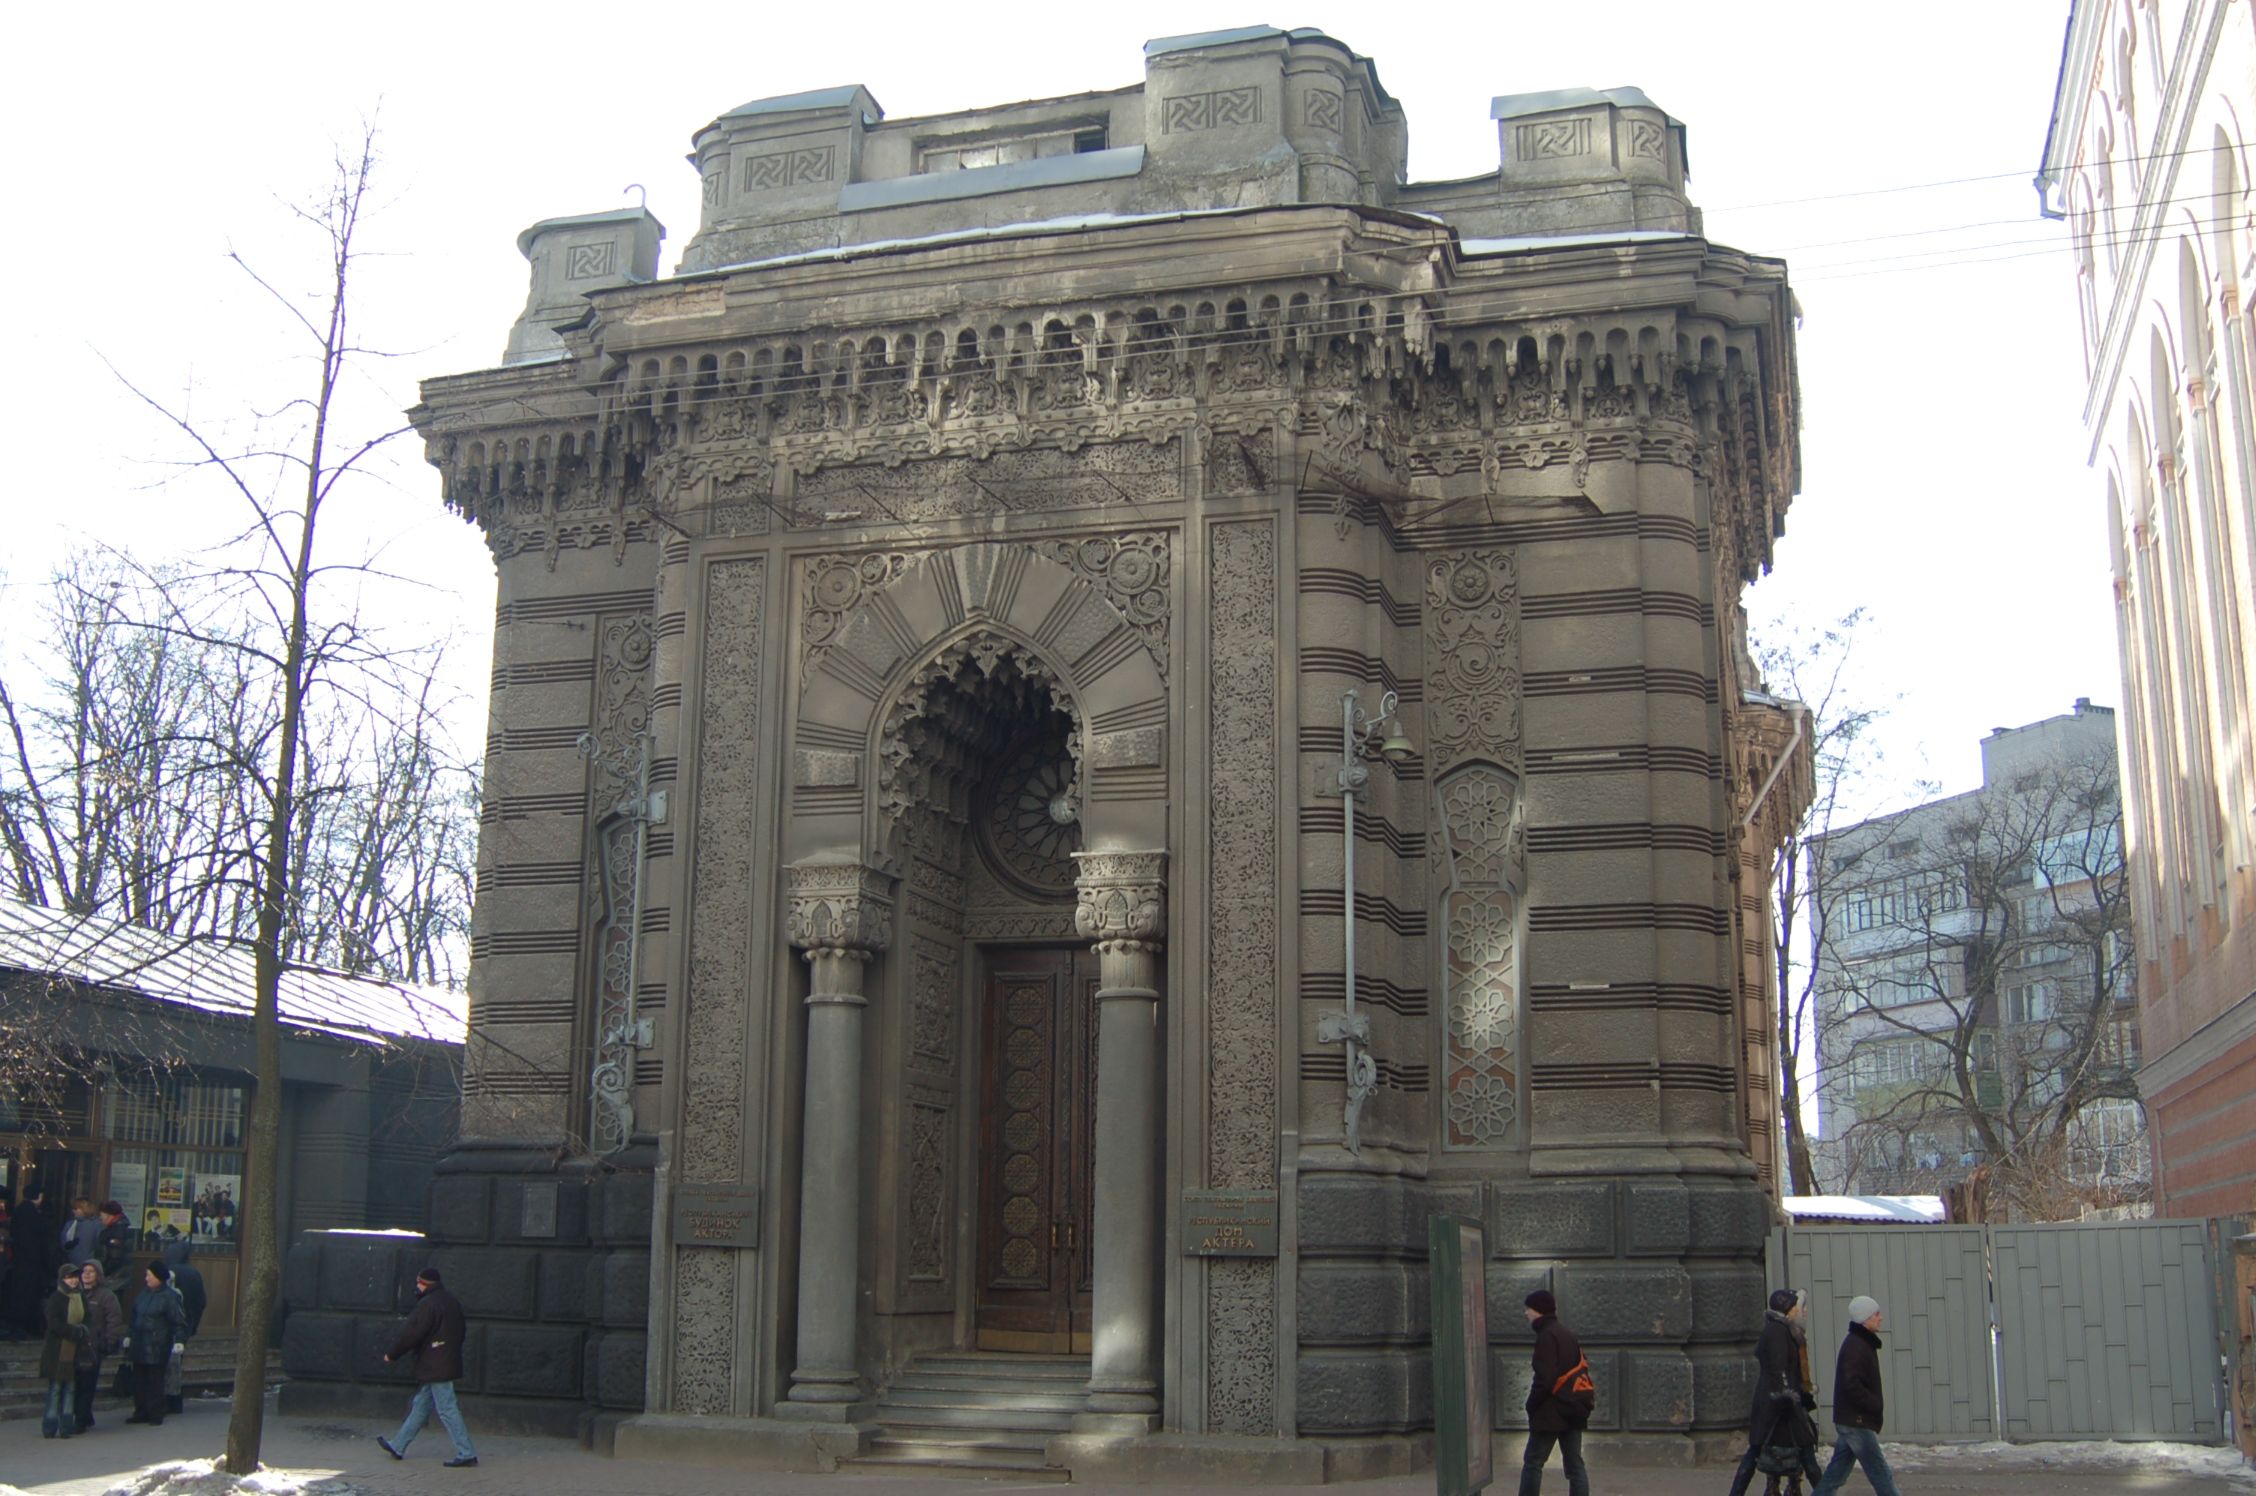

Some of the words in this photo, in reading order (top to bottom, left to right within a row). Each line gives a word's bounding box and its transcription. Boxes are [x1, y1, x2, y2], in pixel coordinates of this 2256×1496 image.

[688, 1217, 742, 1229] БУДИНОК
[694, 1228, 736, 1239] АКТОРА
[1215, 1226, 1243, 1237] ДОМ
[1202, 1238, 1255, 1249] АКТЕРА
